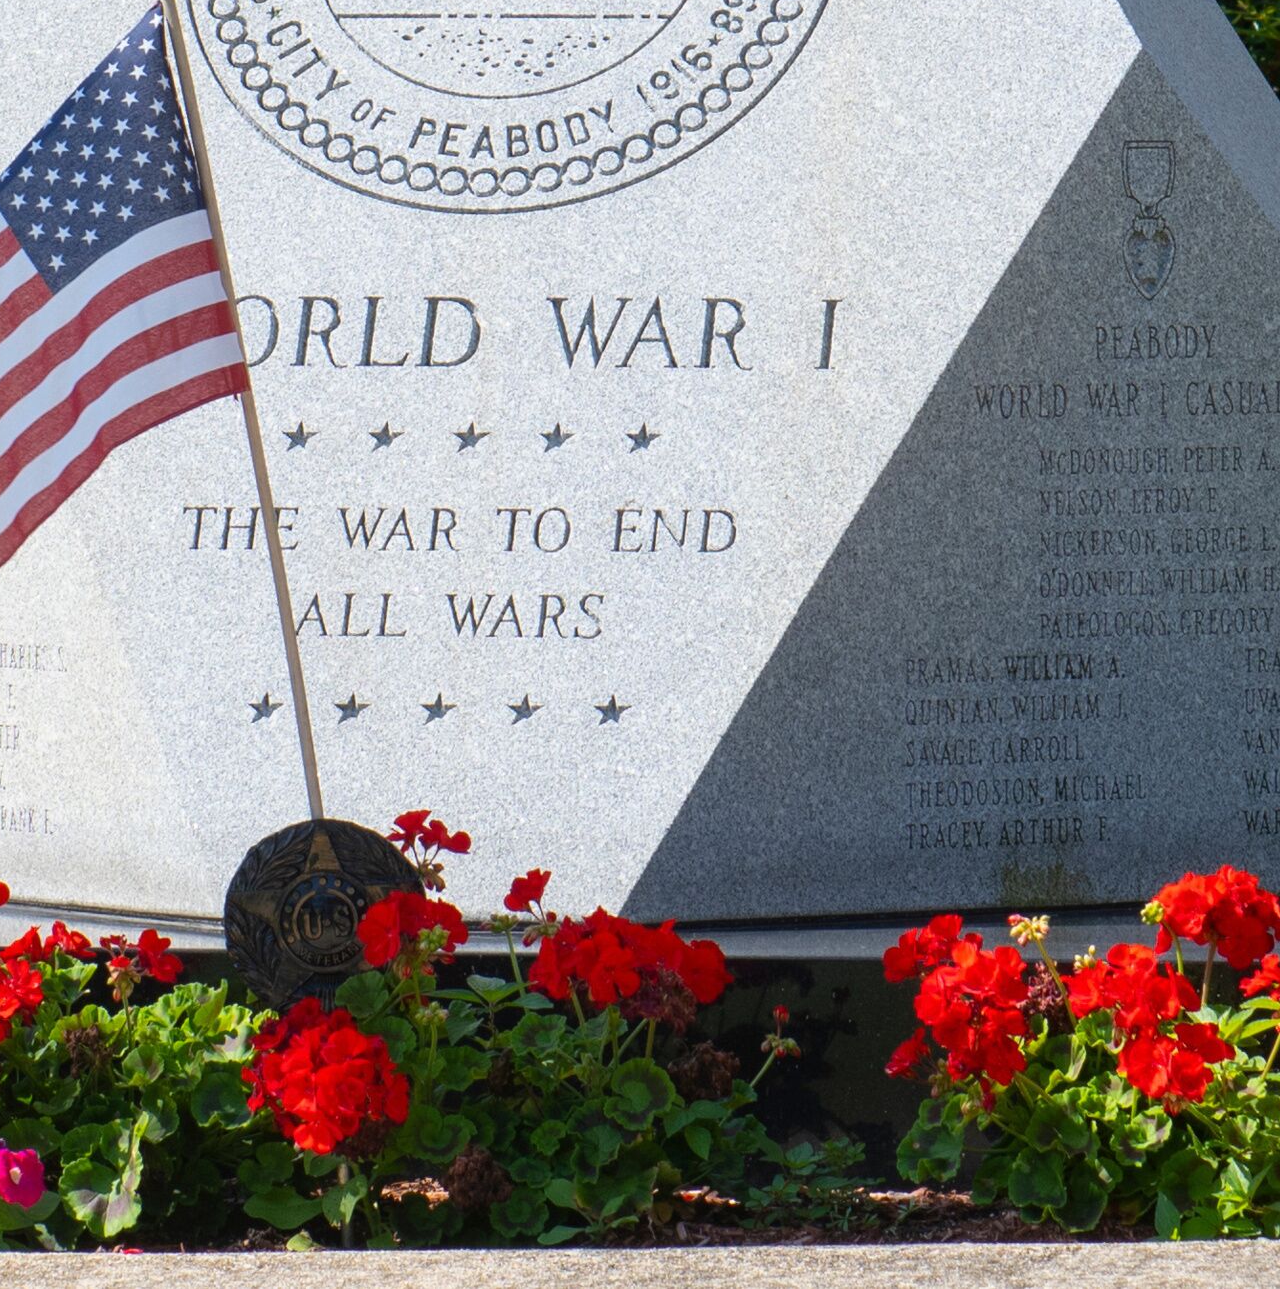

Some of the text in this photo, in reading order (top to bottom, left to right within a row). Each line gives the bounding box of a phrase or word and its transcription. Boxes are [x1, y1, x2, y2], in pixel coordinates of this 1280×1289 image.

[266, 20, 715, 160] CITY OF PEABODY 1916
[231, 294, 843, 371] ORLD WAR I
[1095, 325, 1219, 362] PEABODY
[974, 384, 1070, 420] WORLD
[1086, 381, 1141, 418] WAR
[1183, 446, 1244, 473] PETER
[1256, 447, 1277, 472] A.
[1132, 487, 1196, 515] LEROY
[182, 505, 739, 554] THE WAR TO END
[1170, 526, 1248, 555] GEORGE
[1159, 565, 1250, 594] WILLIAM
[295, 592, 606, 640] ALL WARS
[1179, 607, 1276, 636] GREGORY
[1004, 653, 1094, 682] WILLIAM
[1107, 655, 1126, 679] A.
[1013, 694, 1101, 722] WILLIAM
[991, 735, 1086, 765] CARROLL
[1243, 727, 1280, 755] VAN
[1054, 773, 1147, 803] MICHAEL
[999, 816, 1085, 846] ARTHUR
